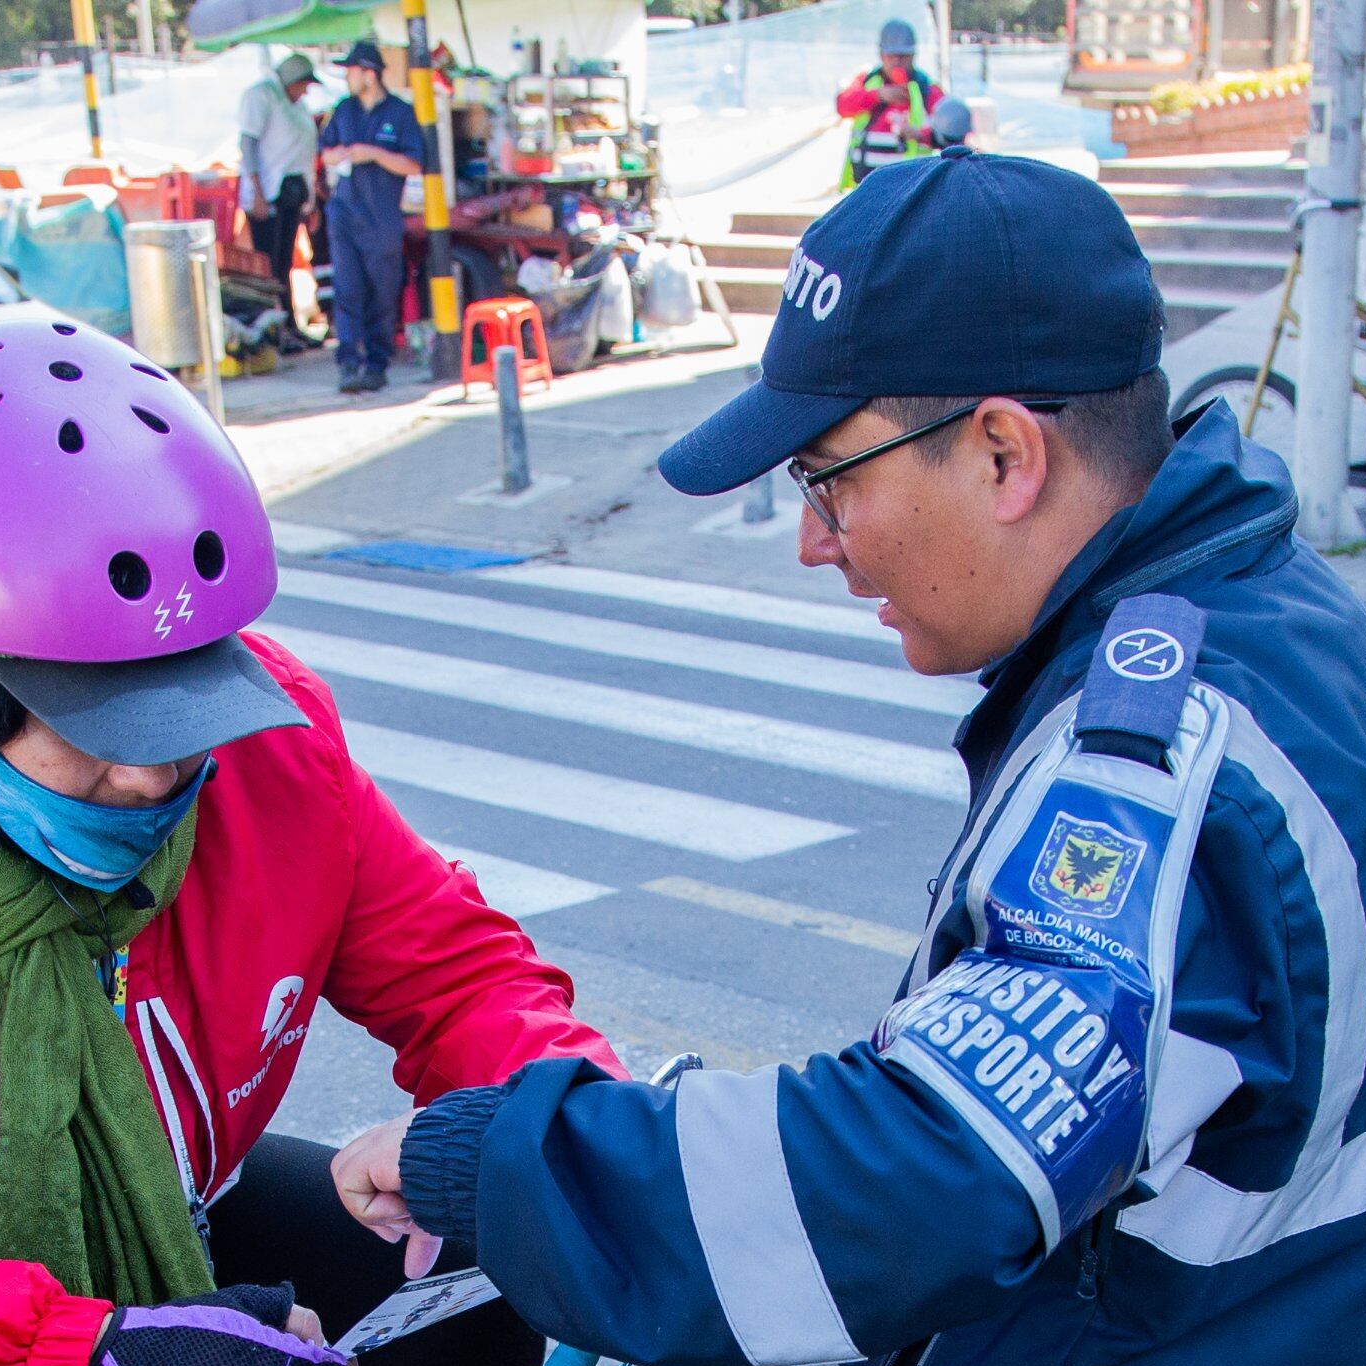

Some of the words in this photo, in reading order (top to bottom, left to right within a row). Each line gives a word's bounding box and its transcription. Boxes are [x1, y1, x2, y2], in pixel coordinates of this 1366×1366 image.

[998, 907, 1072, 933] ALCALDÍA
[1075, 923, 1135, 964] MAYOR
[1005, 929, 1023, 943] DE
[1083, 1043, 1132, 1100] Y
